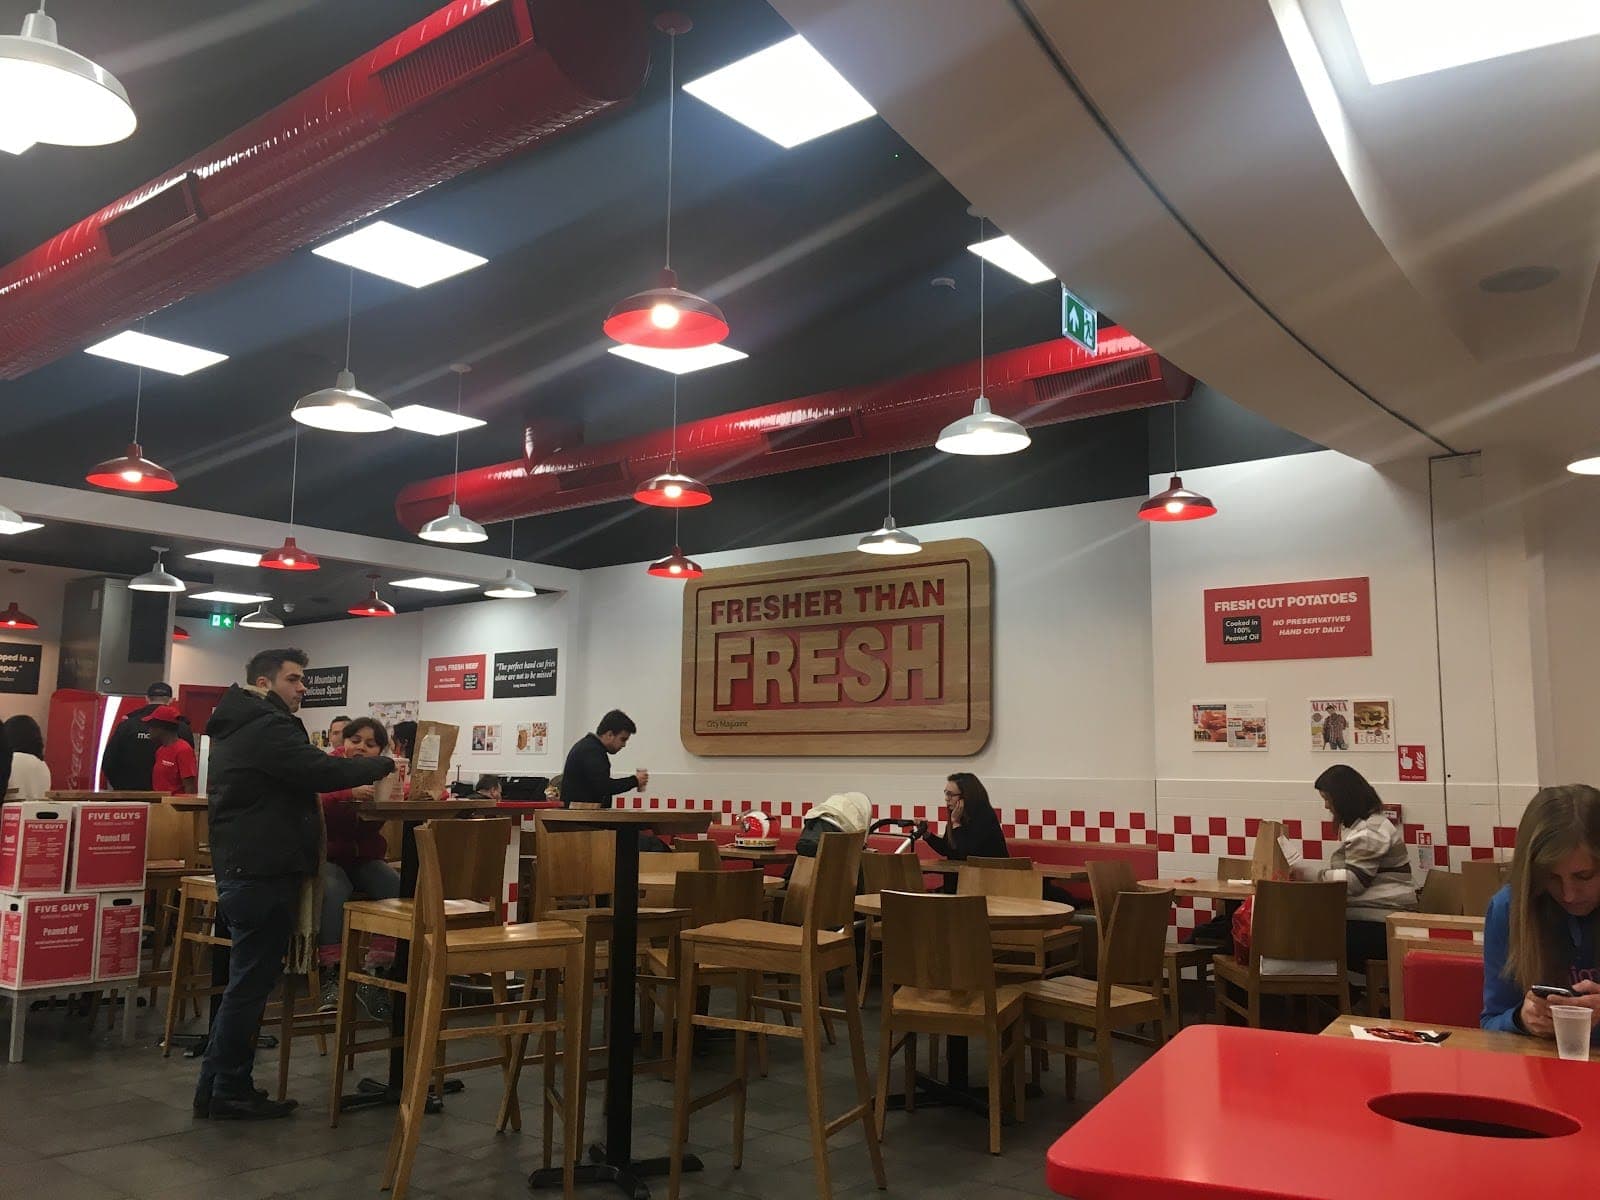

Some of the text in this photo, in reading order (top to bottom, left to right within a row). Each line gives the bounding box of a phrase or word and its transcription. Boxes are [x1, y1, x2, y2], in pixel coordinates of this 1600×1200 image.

[711, 578, 944, 625] FRESHER THAN
[1214, 591, 1358, 613] FRESH CUT POTATOES
[1225, 619, 1259, 629] Cooked in
[1272, 615, 1351, 627] NO PRESERVATIVES
[1303, 627, 1320, 635] CUT
[1321, 625, 1345, 634] DAILY
[1225, 632, 1260, 643] Peanut Oil
[19, 653, 28, 662] in
[714, 622, 944, 706] FRESH
[88, 811, 141, 821] FIVE GUYS
[96, 833, 120, 843] Peanut
[35, 902, 90, 914] FIVE GUYS
[42, 926, 67, 937] Peanut
